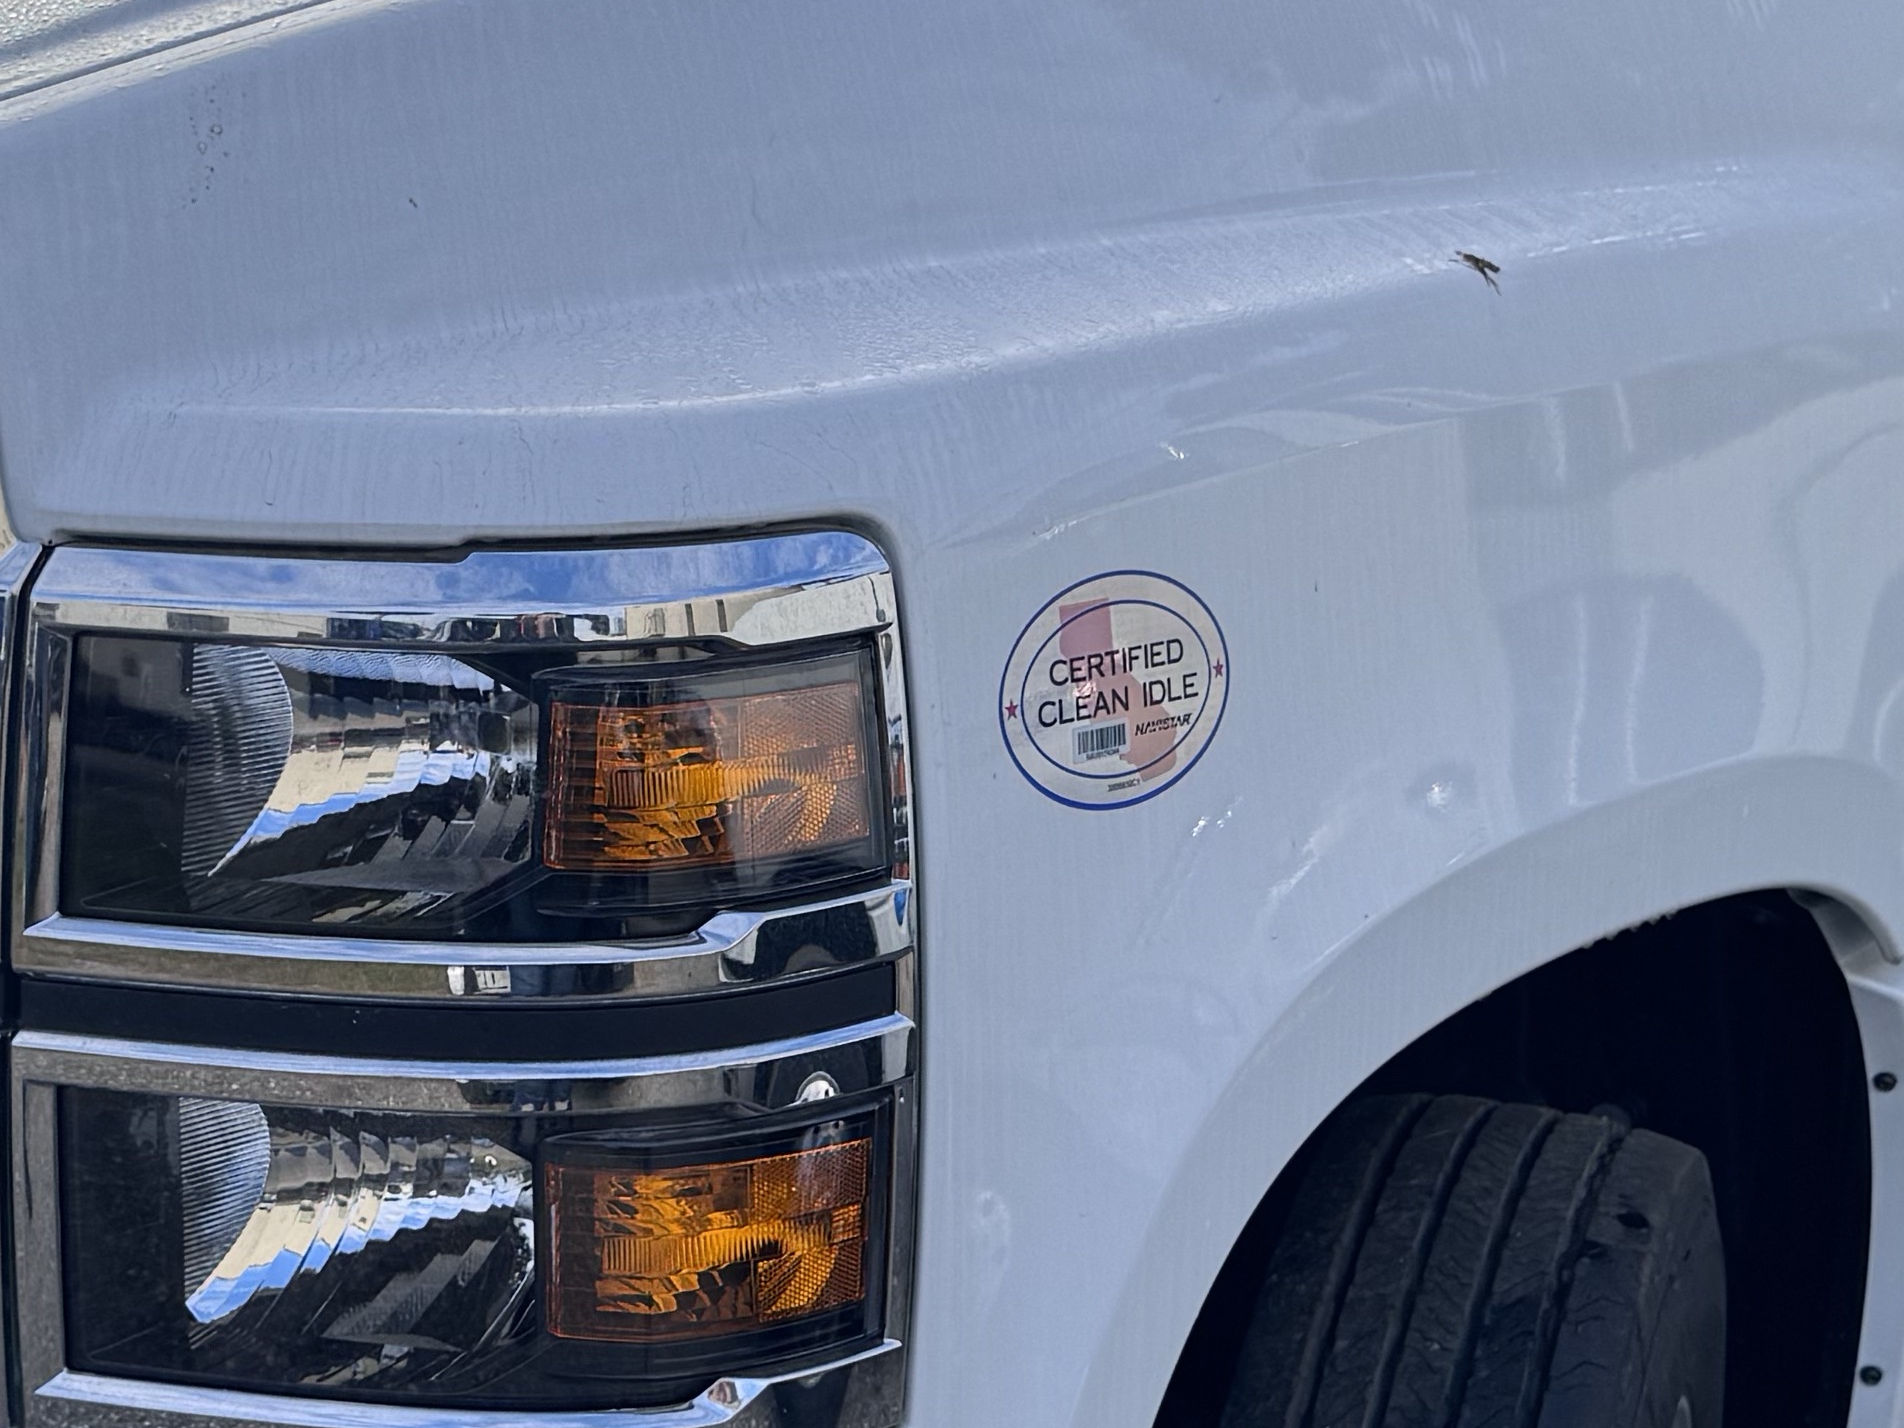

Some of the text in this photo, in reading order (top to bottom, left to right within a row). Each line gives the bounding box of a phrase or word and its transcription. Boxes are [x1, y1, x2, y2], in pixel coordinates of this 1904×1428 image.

[1048, 637, 1184, 687] CERTIFIED
[1037, 672, 1199, 728] CLEAN IDLE
